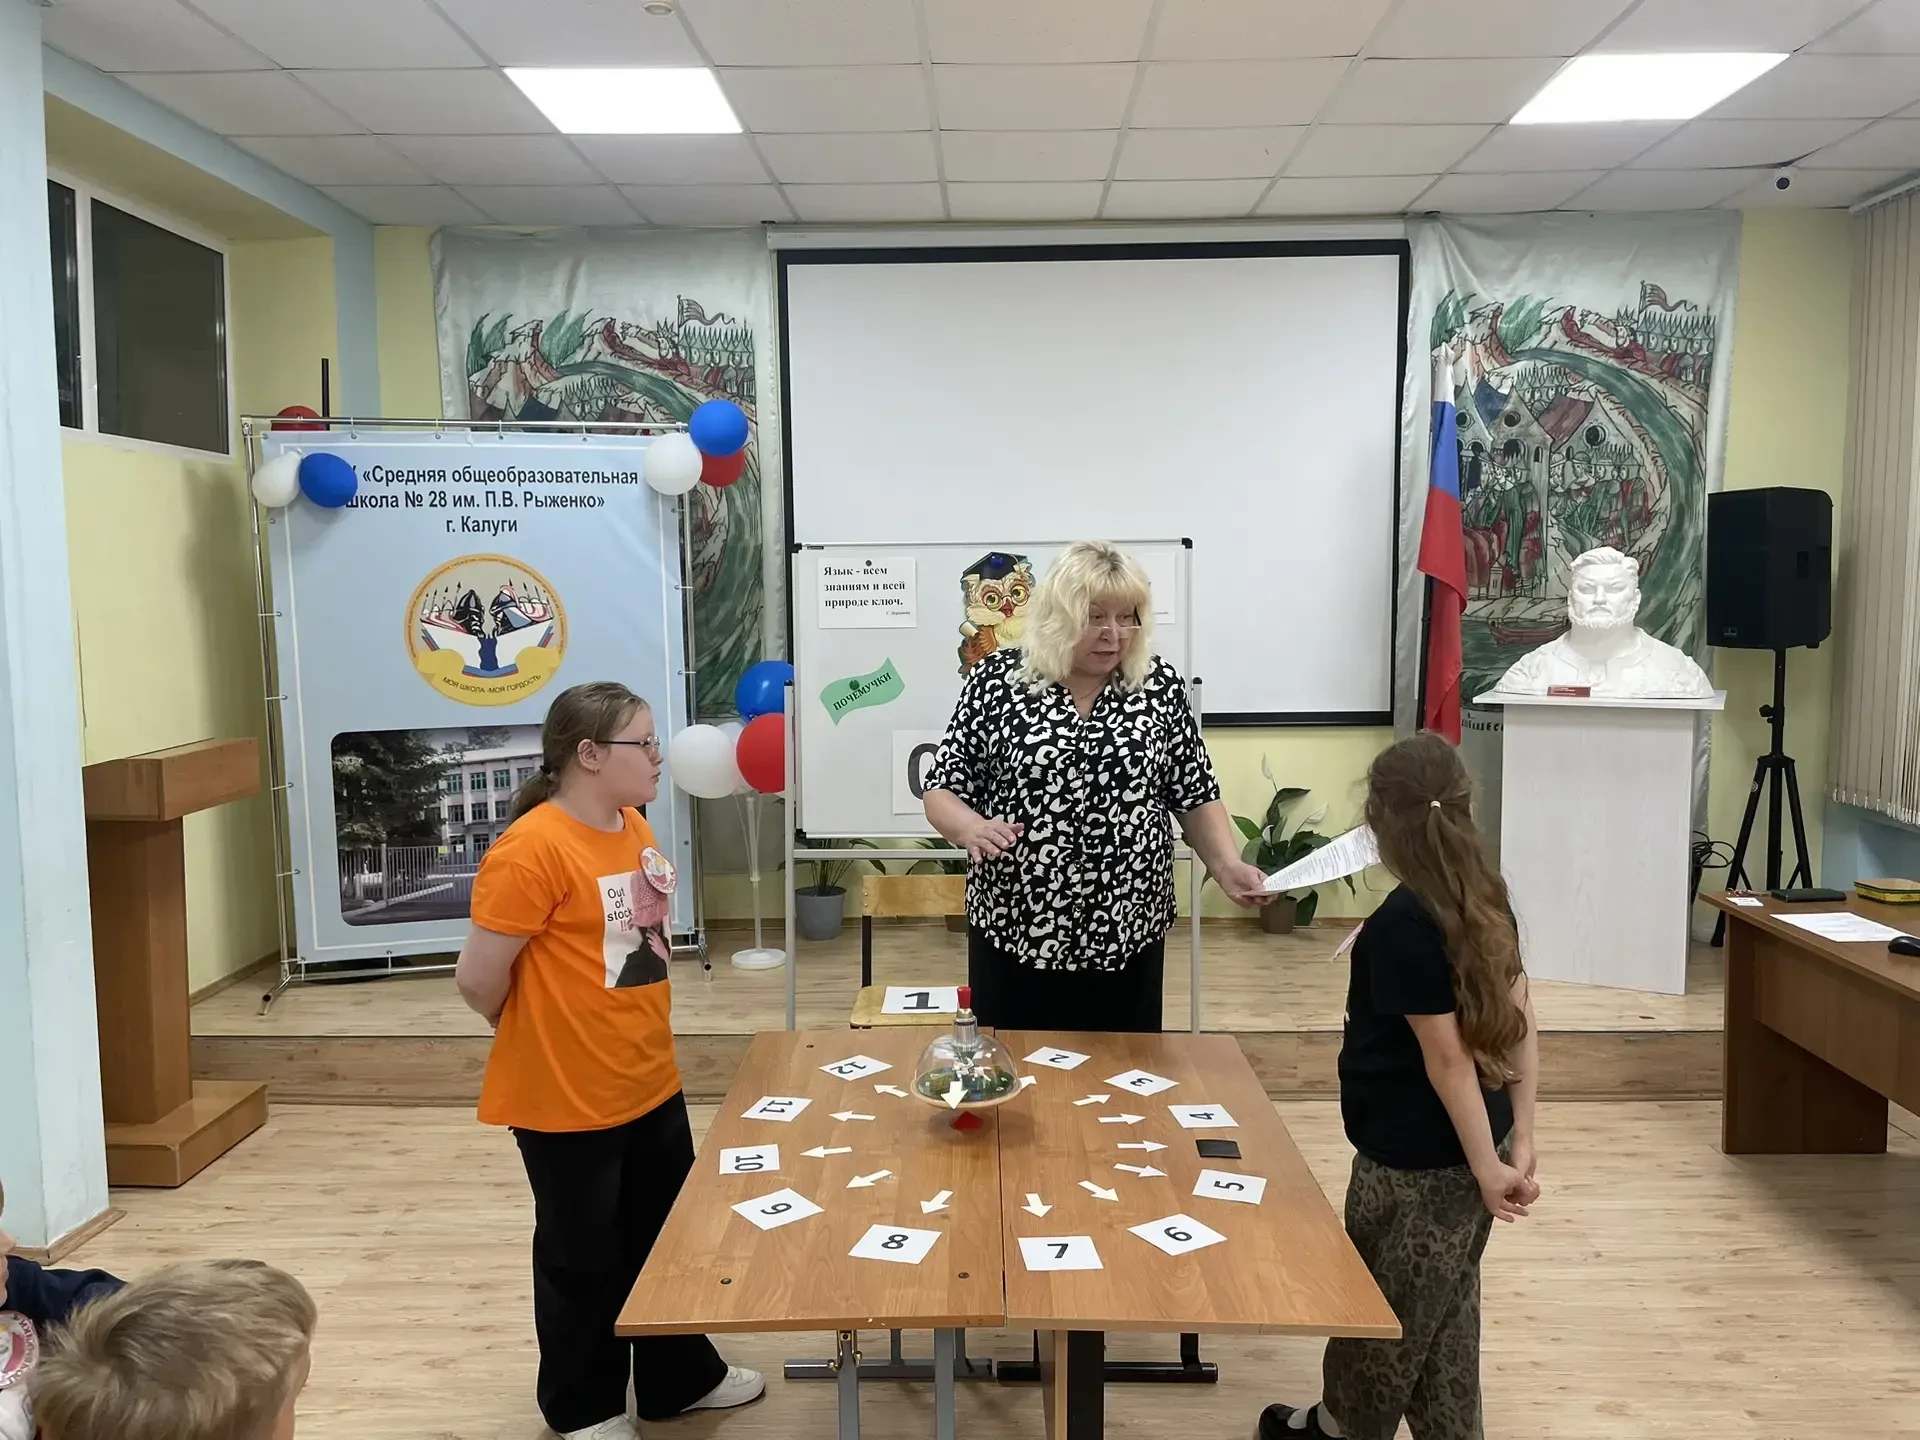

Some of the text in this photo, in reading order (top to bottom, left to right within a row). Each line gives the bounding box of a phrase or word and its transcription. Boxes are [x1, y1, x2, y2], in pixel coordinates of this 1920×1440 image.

[362, 465, 446, 486] «Средняя
[452, 466, 638, 487] общеобразовательная
[404, 491, 423, 508] №
[428, 491, 447, 508] 28
[453, 493, 480, 508] им.
[485, 491, 518, 508] П.В.
[524, 491, 605, 509] Рыженко»
[446, 516, 518, 536] г. Калуги
[824, 567, 854, 576] Язык
[863, 567, 888, 575] всем
[824, 583, 870, 592] знаниям
[882, 581, 906, 590] всей
[825, 598, 903, 609] природе ключ.
[443, 676, 459, 688] МОЯ
[460, 683, 485, 694] ШКОЛА
[507, 674, 542, 691] ГОРДОСТЬ
[832, 672, 892, 711] ПОЧЕМУЧКИ
[607, 887, 625, 899] Out
[614, 898, 625, 909] of
[607, 907, 633, 922] stock
[903, 992, 940, 1010] 1
[1049, 1053, 1070, 1063] 2
[830, 1061, 867, 1074] 12
[1130, 1077, 1154, 1087] 3
[759, 1100, 793, 1114] 11
[1189, 1112, 1215, 1120] 4
[734, 1154, 764, 1171] 10
[1213, 1180, 1245, 1191] 5
[759, 1201, 793, 1216] 9
[1164, 1226, 1193, 1242] 6
[881, 1234, 909, 1250] 8
[1047, 1243, 1069, 1259] 7
